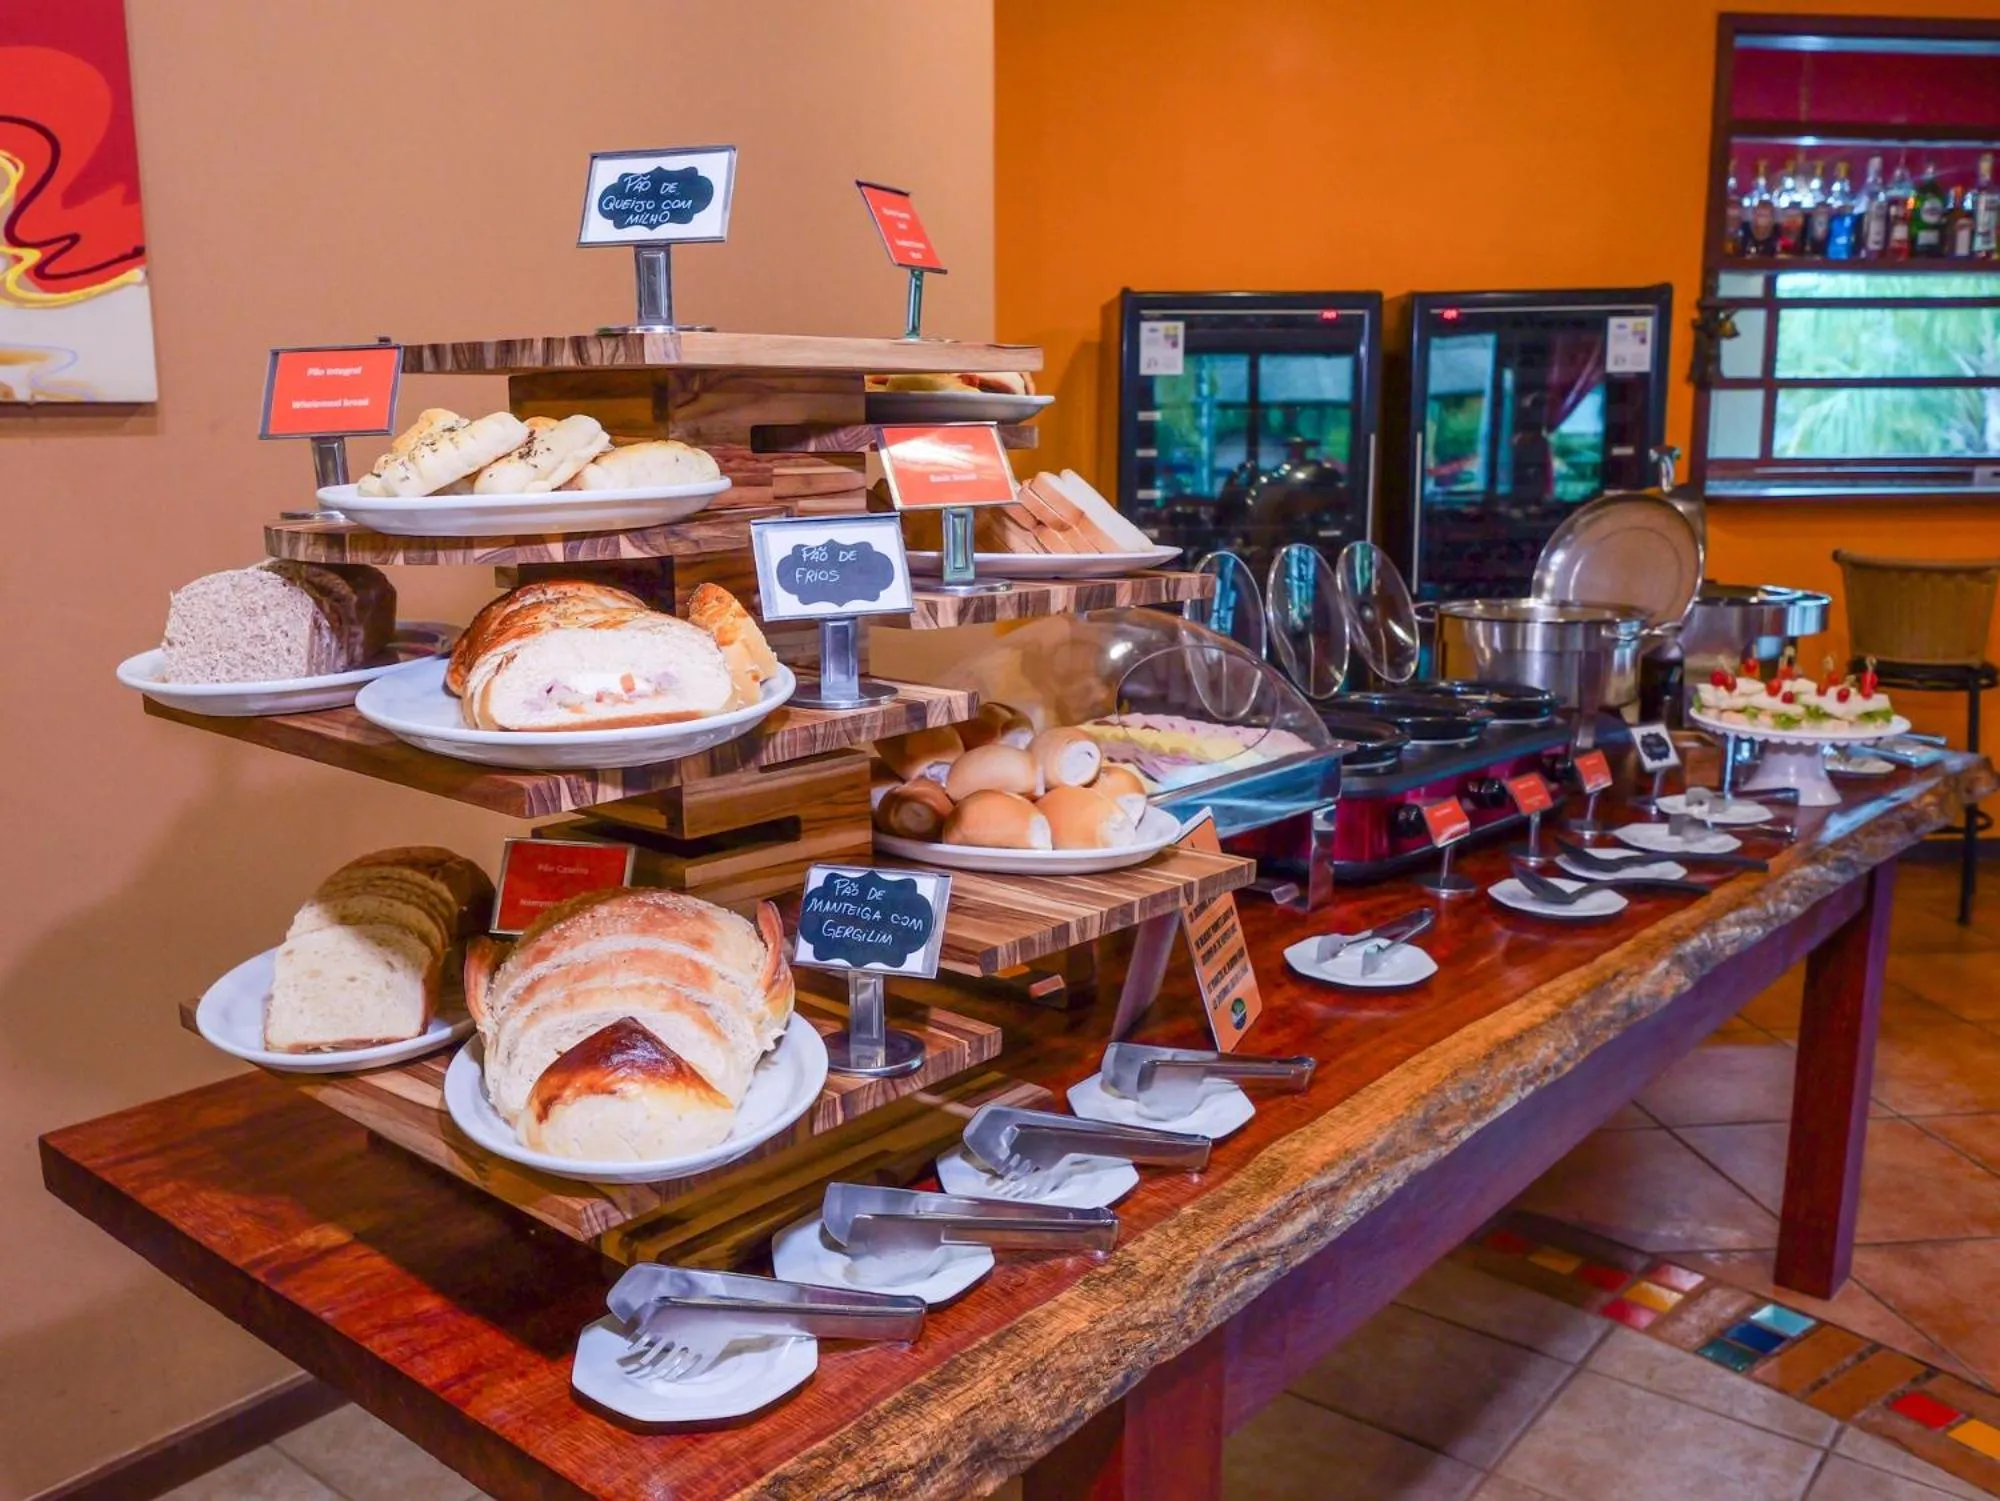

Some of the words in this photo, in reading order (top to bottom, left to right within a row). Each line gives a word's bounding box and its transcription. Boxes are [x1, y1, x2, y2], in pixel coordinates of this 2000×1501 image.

[660, 182, 679, 195] DE
[661, 199, 693, 210] COM
[624, 210, 671, 225] MILHO
[838, 550, 859, 562] DE
[795, 567, 841, 585] FRIOS
[866, 887, 887, 901] DE
[806, 897, 882, 922] MANTEIGA
[890, 913, 924, 932] COM
